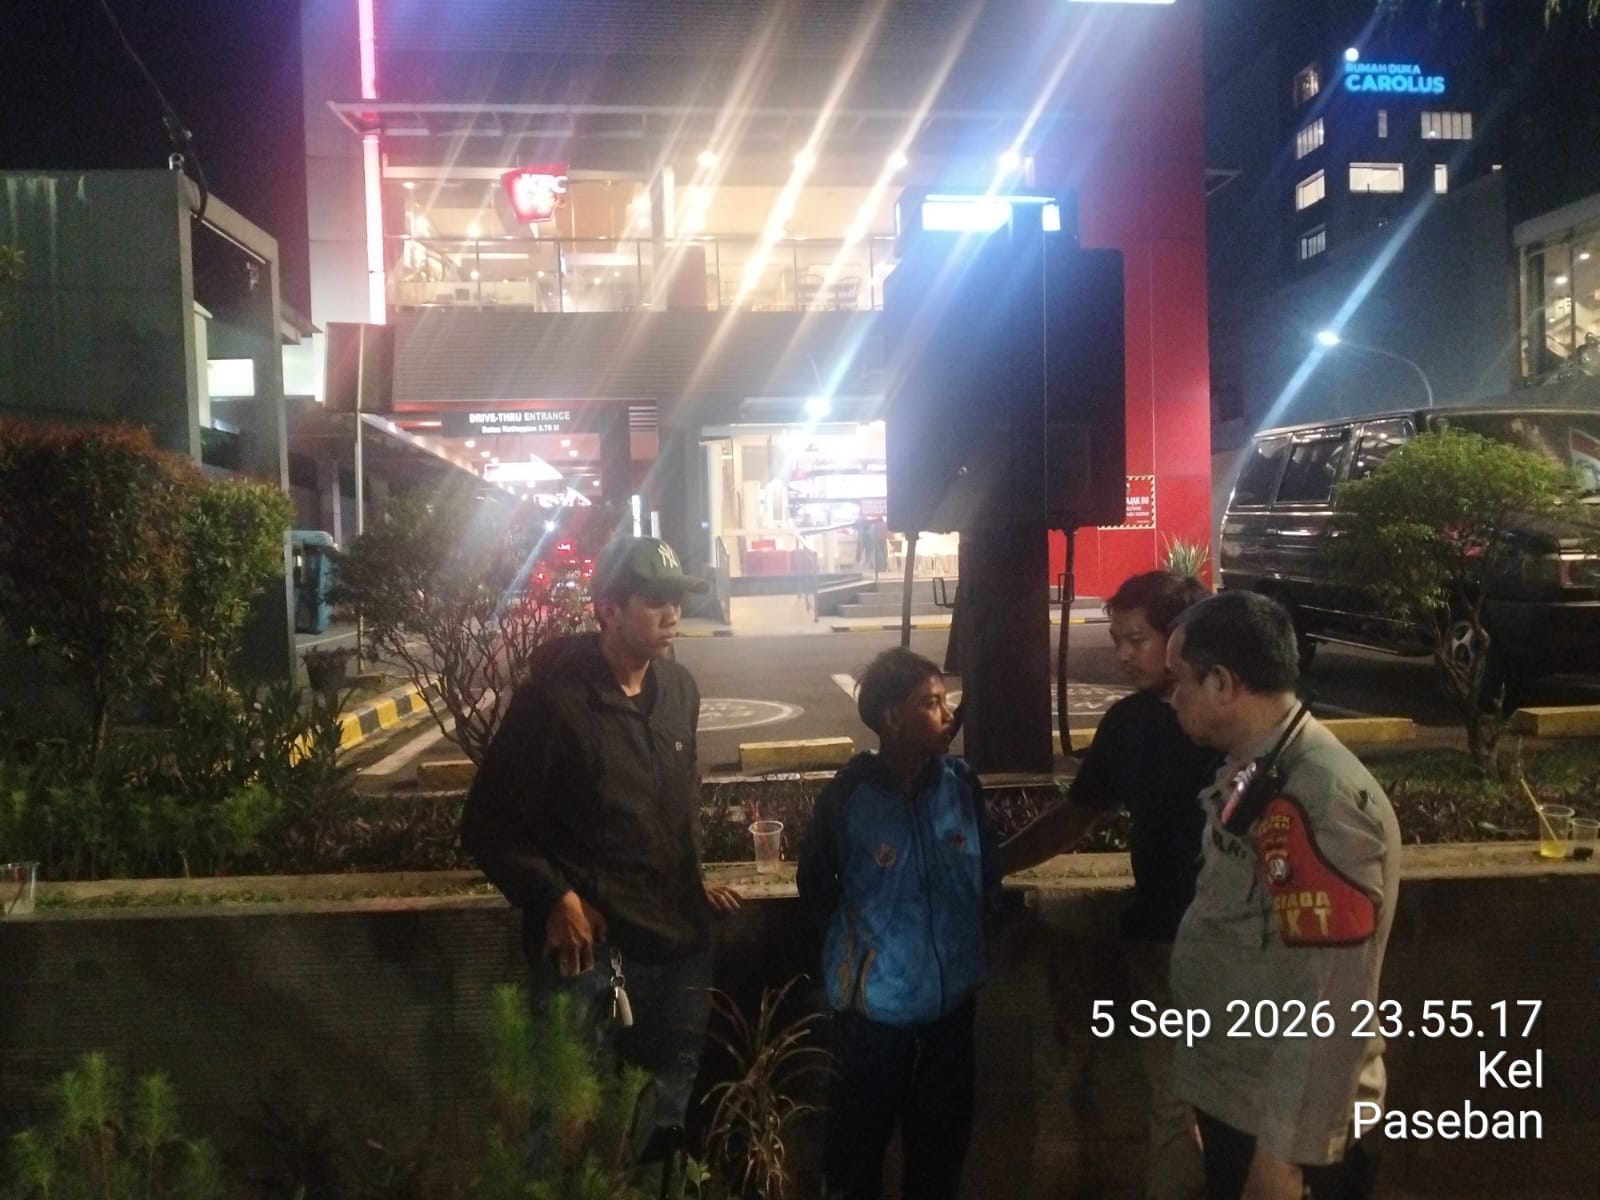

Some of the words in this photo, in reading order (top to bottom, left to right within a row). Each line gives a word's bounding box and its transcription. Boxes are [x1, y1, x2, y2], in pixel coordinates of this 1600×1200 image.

[1389, 64, 1421, 74] DUKA
[1345, 74, 1445, 94] CAROLUS
[469, 412, 522, 423] DRIVE-THRU
[524, 411, 570, 421] ENTRANCE
